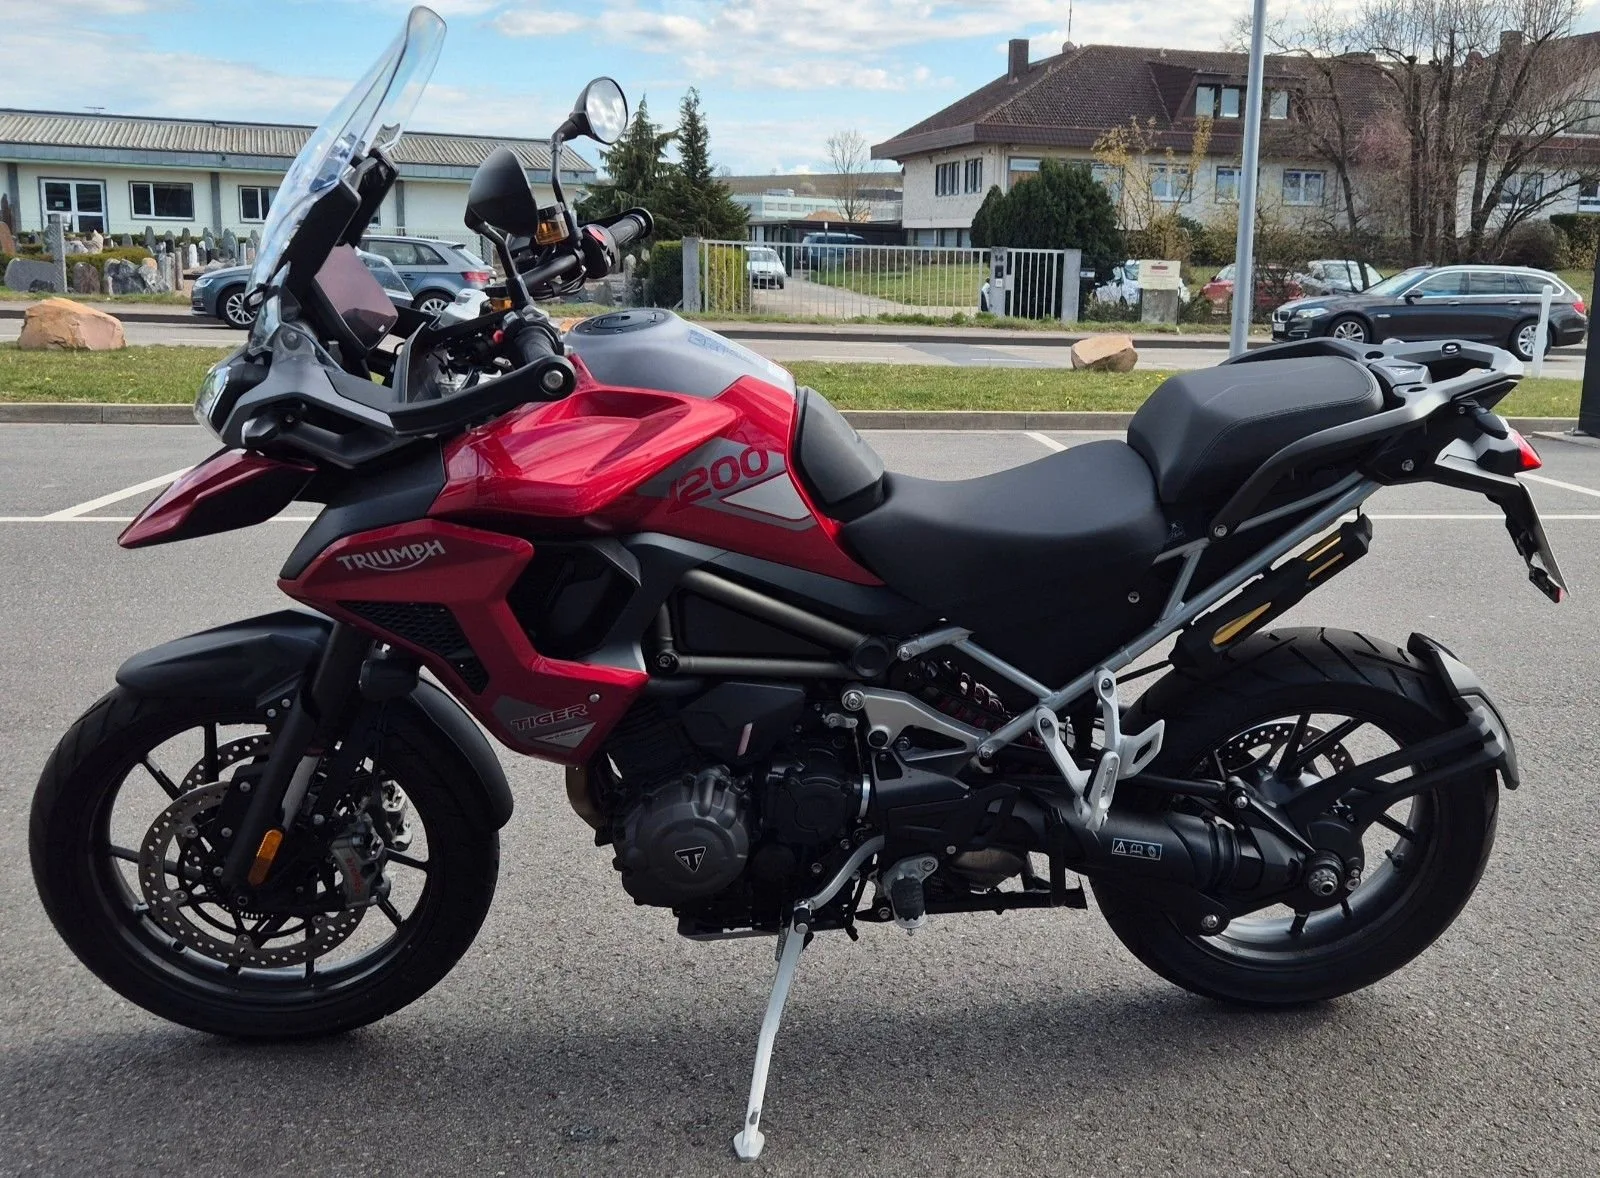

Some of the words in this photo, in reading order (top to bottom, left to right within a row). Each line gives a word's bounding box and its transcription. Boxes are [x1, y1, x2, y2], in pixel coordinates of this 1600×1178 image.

[667, 445, 769, 513] 1200
[336, 540, 446, 571] TRIUMPH
[510, 703, 588, 730] TIGER
